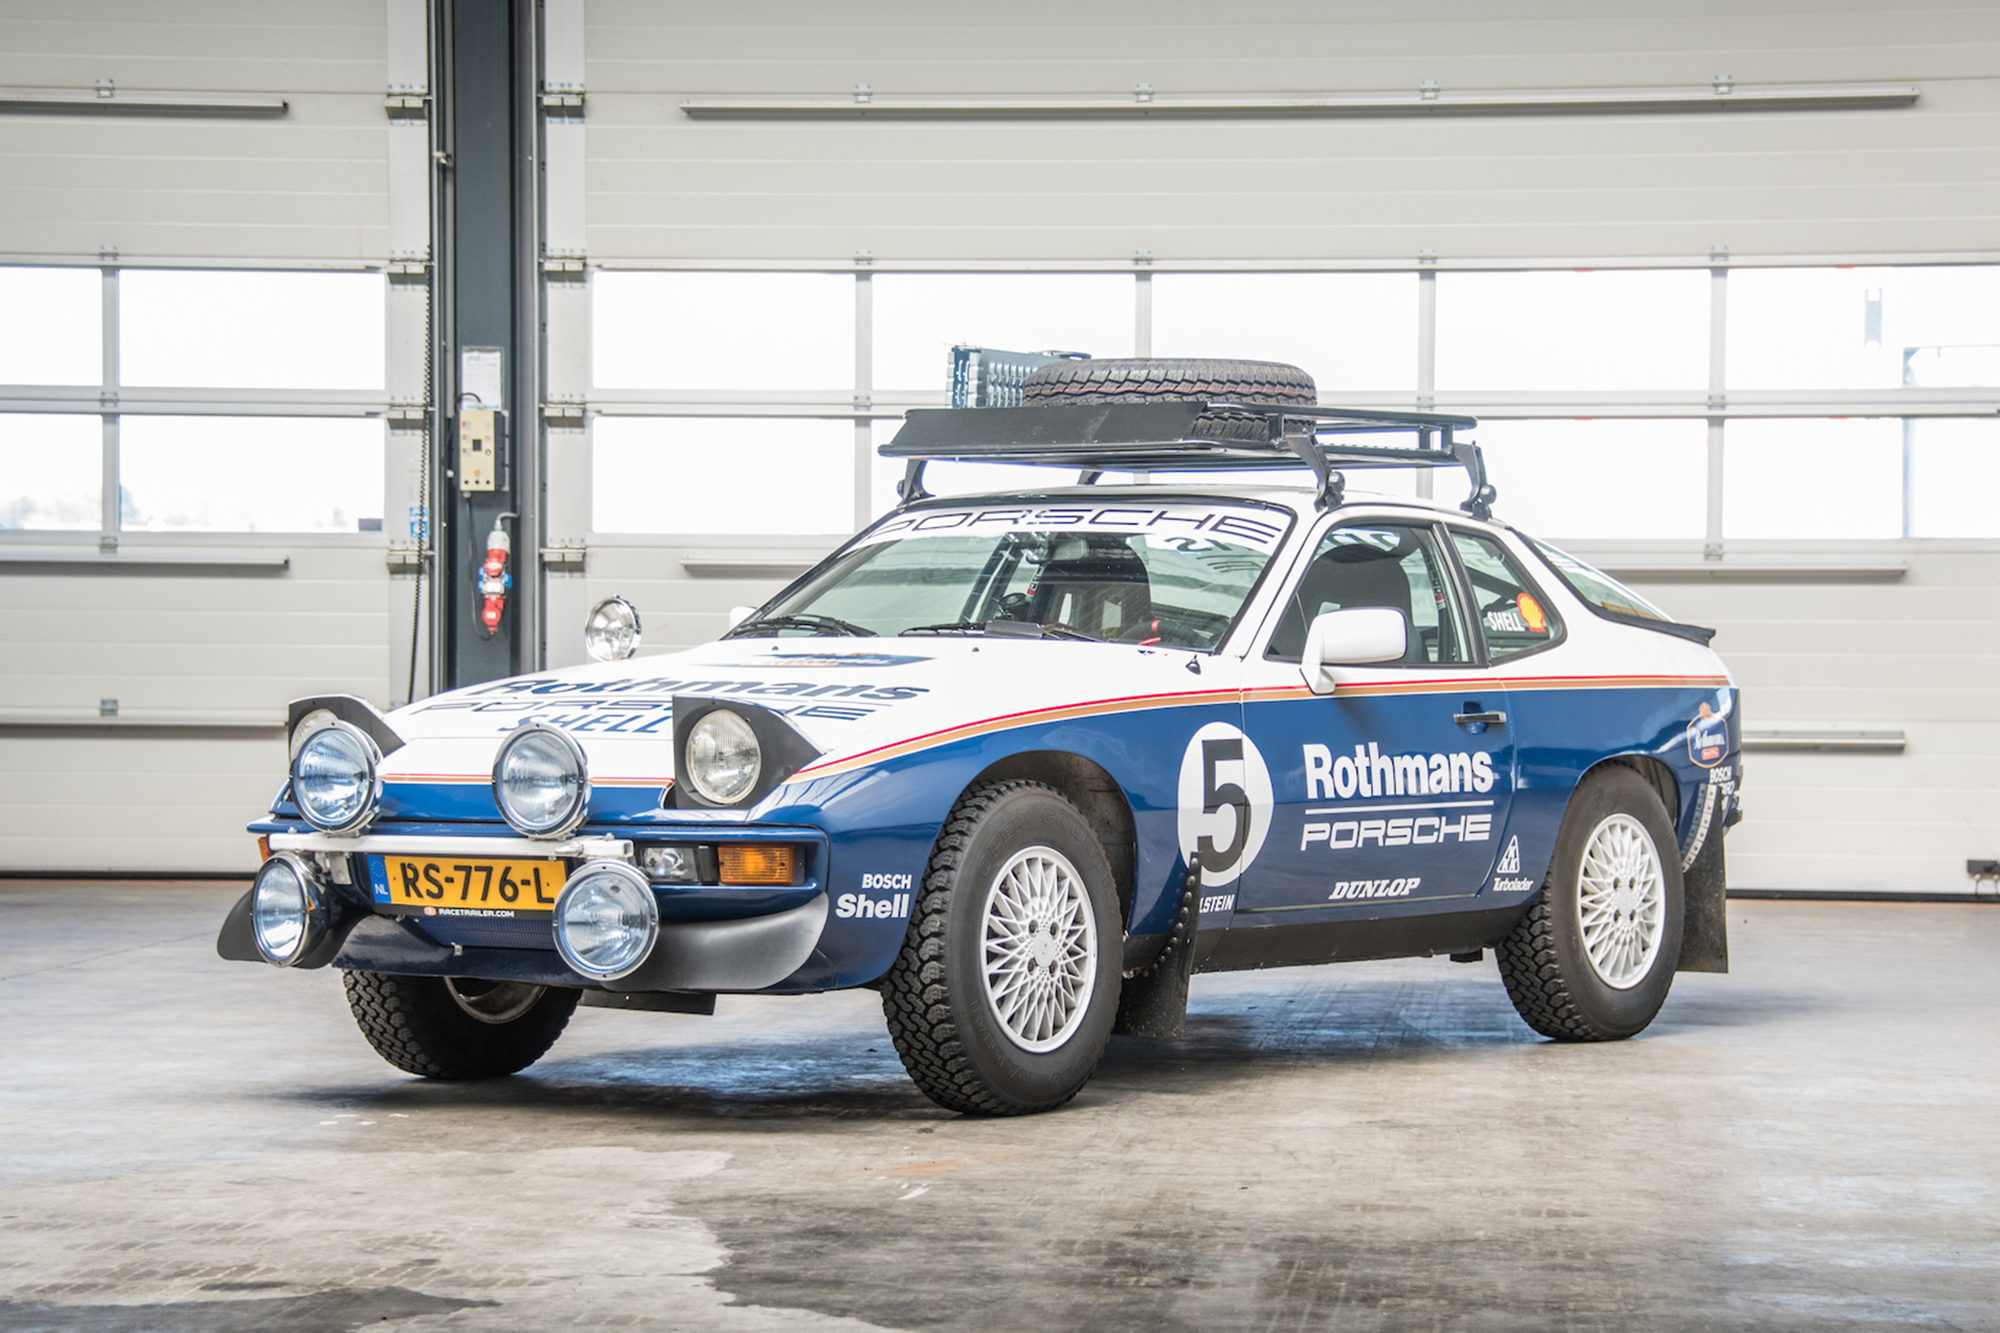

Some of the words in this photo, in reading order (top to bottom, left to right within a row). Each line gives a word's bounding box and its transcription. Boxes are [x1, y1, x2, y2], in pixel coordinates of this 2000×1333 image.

[857, 508, 1283, 544] PORSCHE
[1487, 611, 1526, 632] SHELL
[464, 677, 931, 701] Rothmans
[408, 699, 877, 721] PORSE
[1302, 742, 1494, 800] Rothmans
[1709, 766, 1732, 784] BOSCH
[1196, 738, 1253, 873] 5
[1300, 813, 1493, 851] PORSCHE
[374, 883, 389, 896] NL
[400, 862, 555, 904] RS-776-L
[861, 873, 912, 890] BOSCH
[1328, 878, 1421, 900] DUNLOP
[1492, 877, 1534, 892] Turbolader
[438, 907, 515, 918] RACETRAILER.COM
[835, 893, 910, 919] Shell
[1198, 894, 1235, 914] LSTEIN
